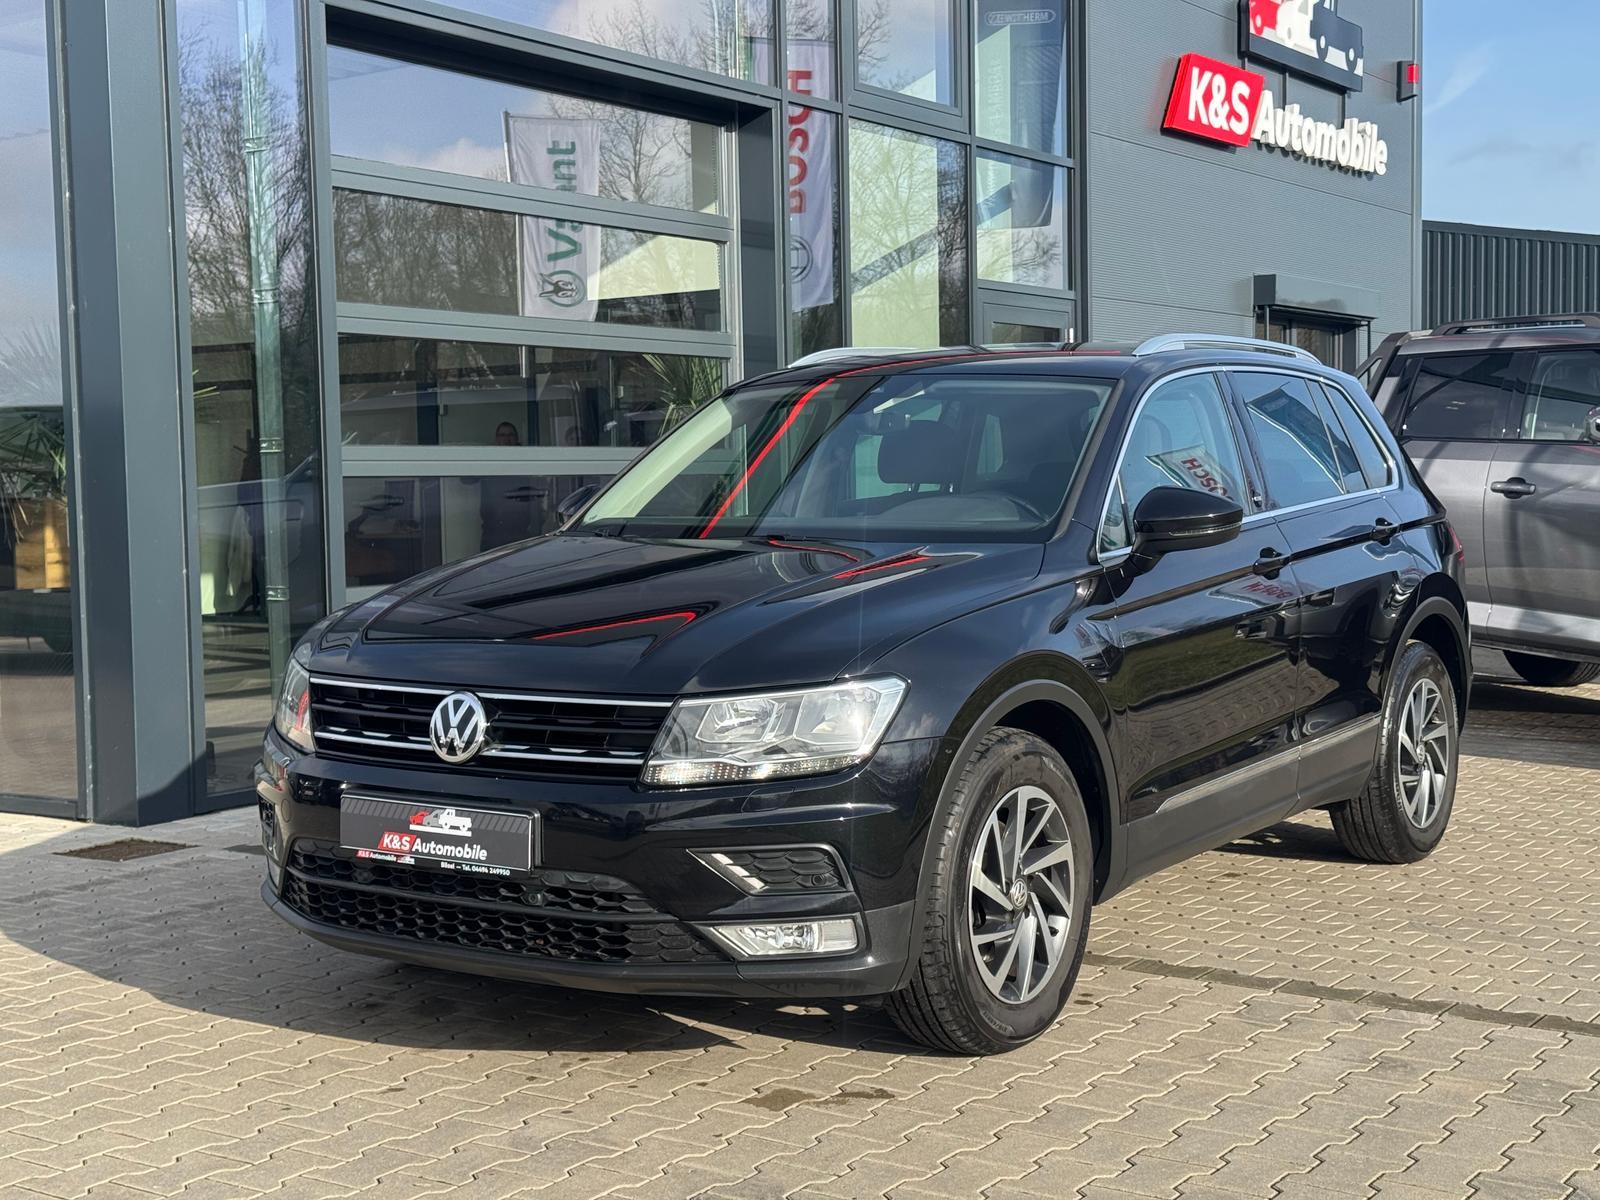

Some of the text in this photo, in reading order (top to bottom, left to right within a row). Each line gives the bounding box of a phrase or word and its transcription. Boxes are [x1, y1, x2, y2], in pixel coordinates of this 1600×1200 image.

[1188, 66, 1388, 175] K&S Automobile
[1181, 458, 1234, 501] OSCH
[383, 834, 488, 861] K&S Automobile
